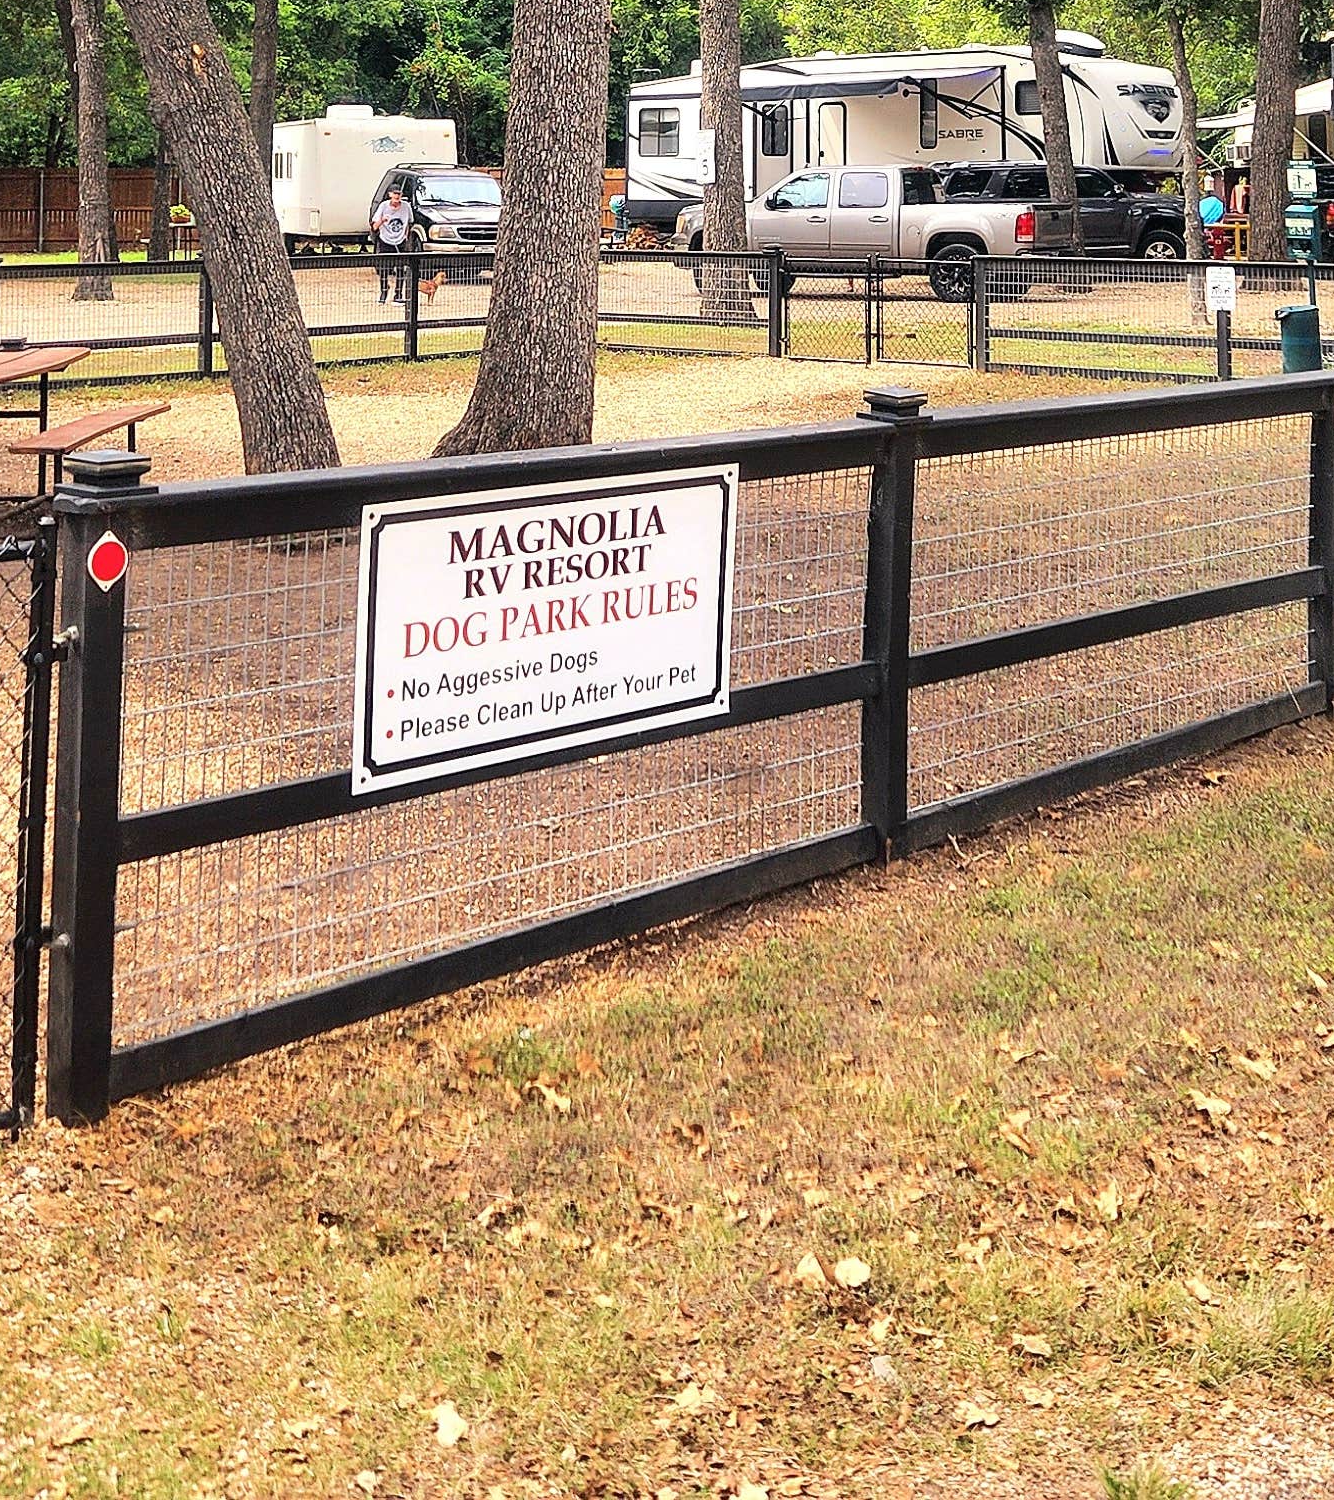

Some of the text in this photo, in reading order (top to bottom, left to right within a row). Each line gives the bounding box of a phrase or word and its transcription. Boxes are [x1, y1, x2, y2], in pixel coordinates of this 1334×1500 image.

[1116, 84, 1179, 99] SABRE
[938, 129, 984, 139] SABRE
[447, 505, 667, 565] MAGNOLIA
[462, 544, 653, 600] RV RESORT
[403, 576, 699, 659] DOG PARK RULES
[400, 663, 697, 742] Please Clean Up After Your Pet
[401, 648, 599, 702] No Aggessive Dogs
